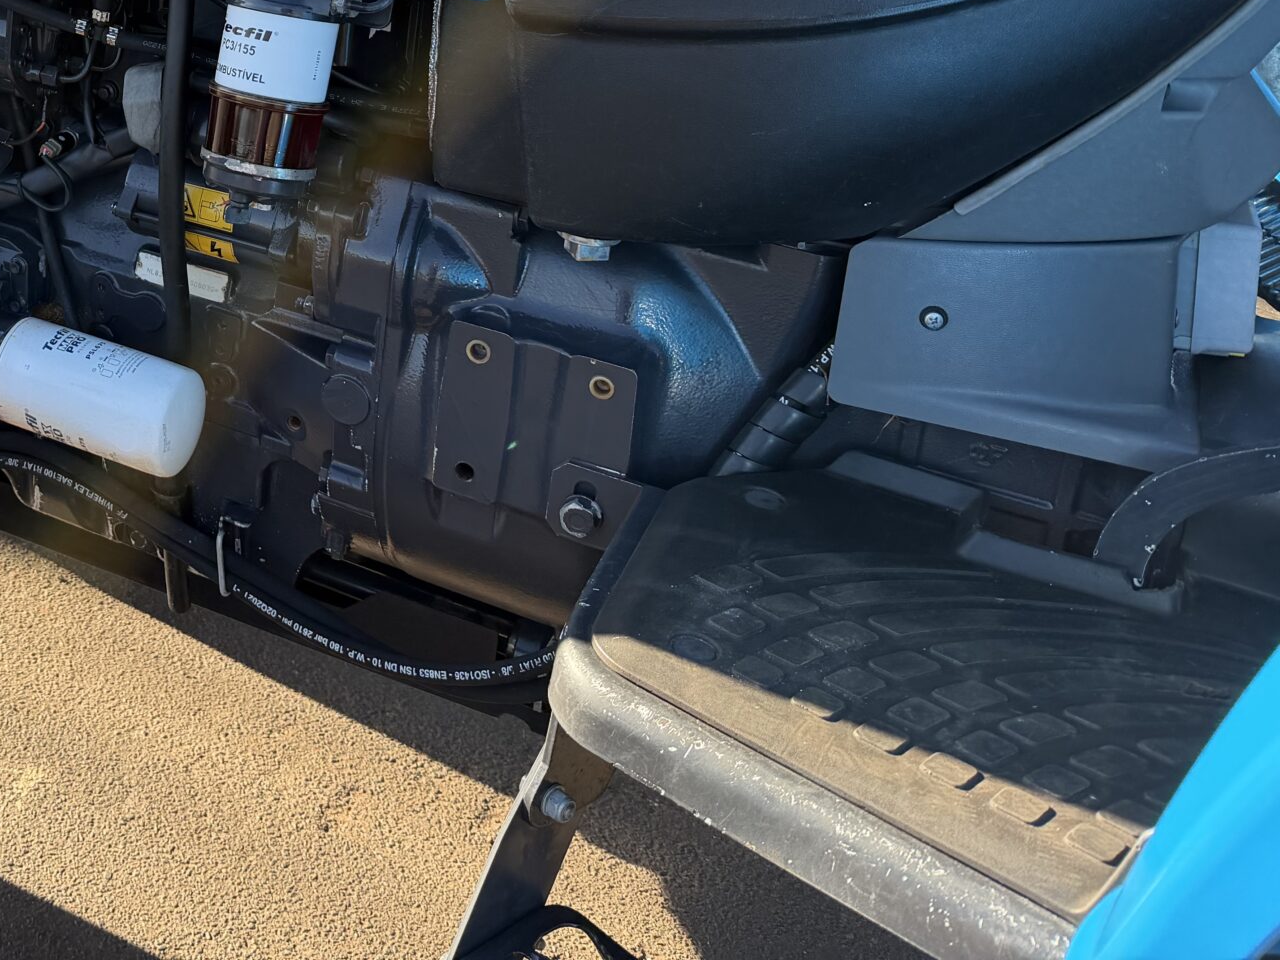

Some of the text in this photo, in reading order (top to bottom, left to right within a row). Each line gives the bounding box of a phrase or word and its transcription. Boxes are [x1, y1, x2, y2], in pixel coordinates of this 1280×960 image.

[224, 22, 273, 42] ecfil
[216, 62, 265, 84] MBUSTÍVEL
[43, 467, 74, 487] SAE100
[73, 481, 114, 511] WIREFLEX
[281, 617, 294, 627] psi
[293, 622, 314, 639] 2610
[313, 633, 329, 647] bar
[329, 641, 344, 654] 180
[371, 657, 383, 667] 10
[384, 661, 399, 672] DN
[399, 666, 417, 676] 1SN
[419, 669, 448, 680] EN853
[454, 670, 491, 680] ISO1436
